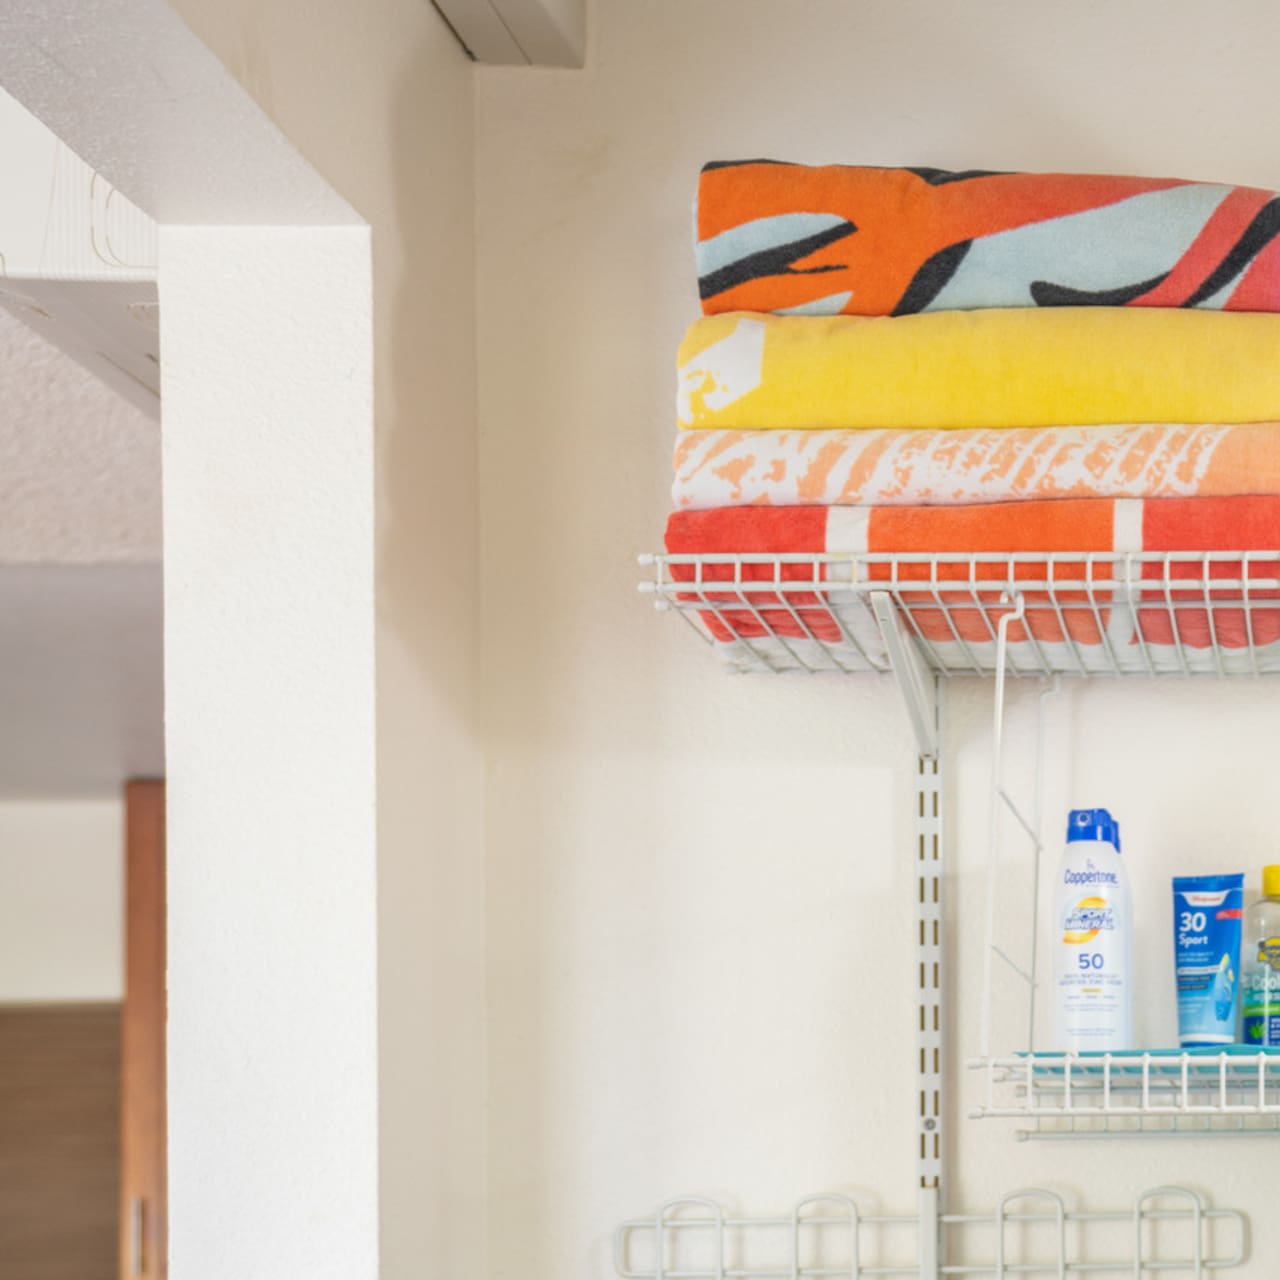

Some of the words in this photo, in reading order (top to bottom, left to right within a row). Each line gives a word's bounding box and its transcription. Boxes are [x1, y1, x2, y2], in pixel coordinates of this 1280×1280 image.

[1064, 869, 1118, 885] Coppertone
[1179, 911, 1207, 932] 30
[1178, 933, 1208, 949] Sport
[1079, 953, 1104, 969] 50
